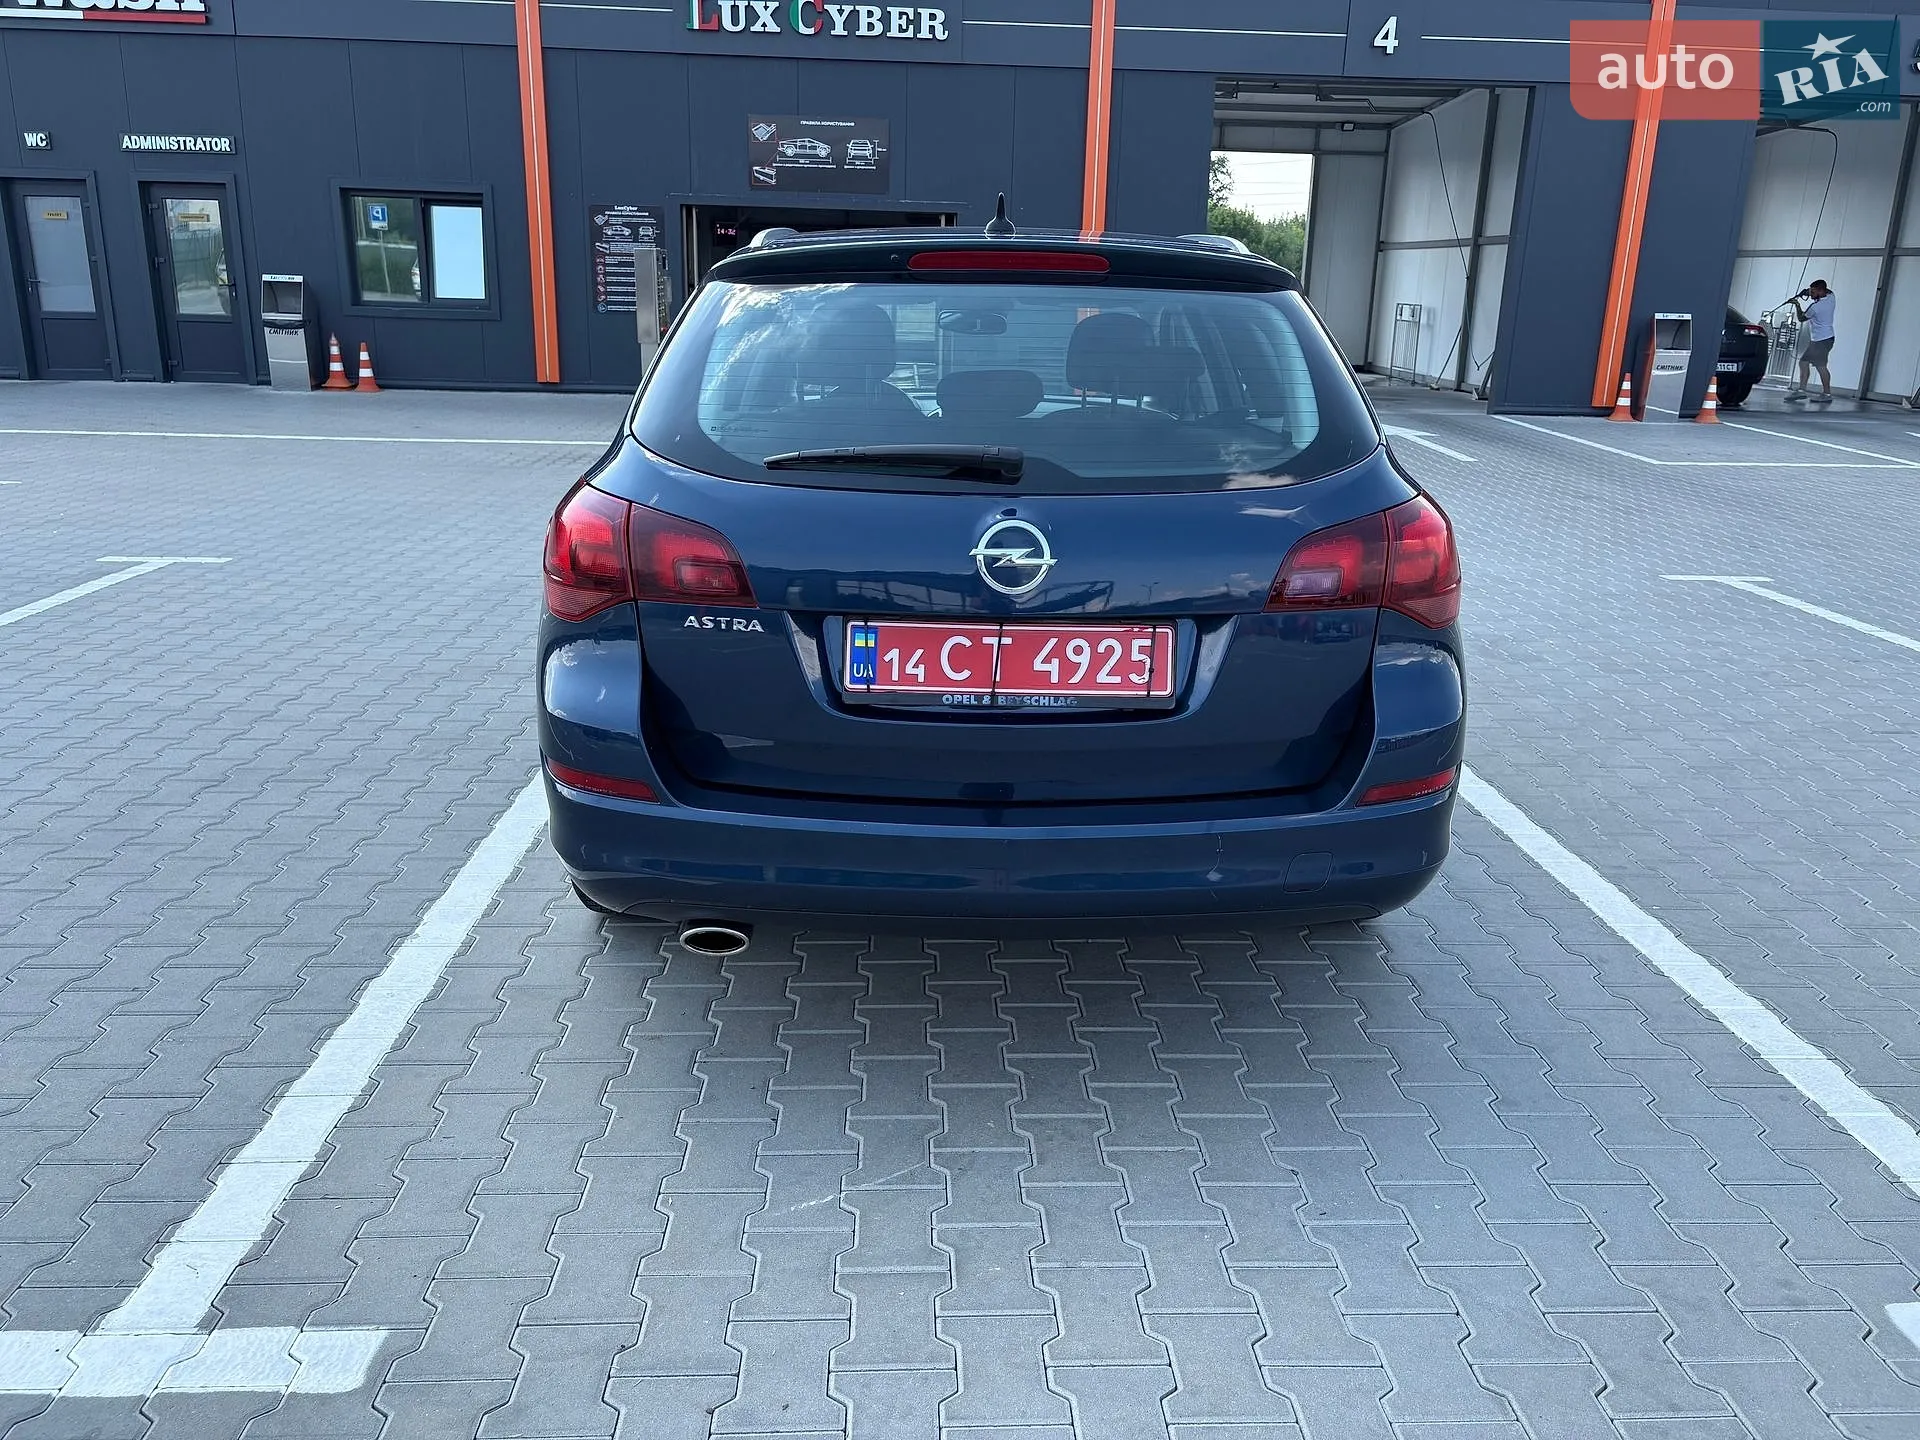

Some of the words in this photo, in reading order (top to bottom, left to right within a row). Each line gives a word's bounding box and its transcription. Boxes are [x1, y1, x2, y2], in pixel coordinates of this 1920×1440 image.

[687, 0, 781, 32] LUX
[789, 0, 949, 40] CYBER
[1373, 16, 1399, 54] 4
[23, 132, 49, 147] WC
[122, 135, 231, 151] ADMINISTRATOR
[684, 615, 765, 632] ASTRA
[853, 663, 874, 678] UA
[883, 648, 926, 683] 14
[939, 635, 1013, 682] CT
[1032, 637, 1152, 684] 4925
[942, 694, 978, 705] OPEL
[982, 695, 991, 705] &
